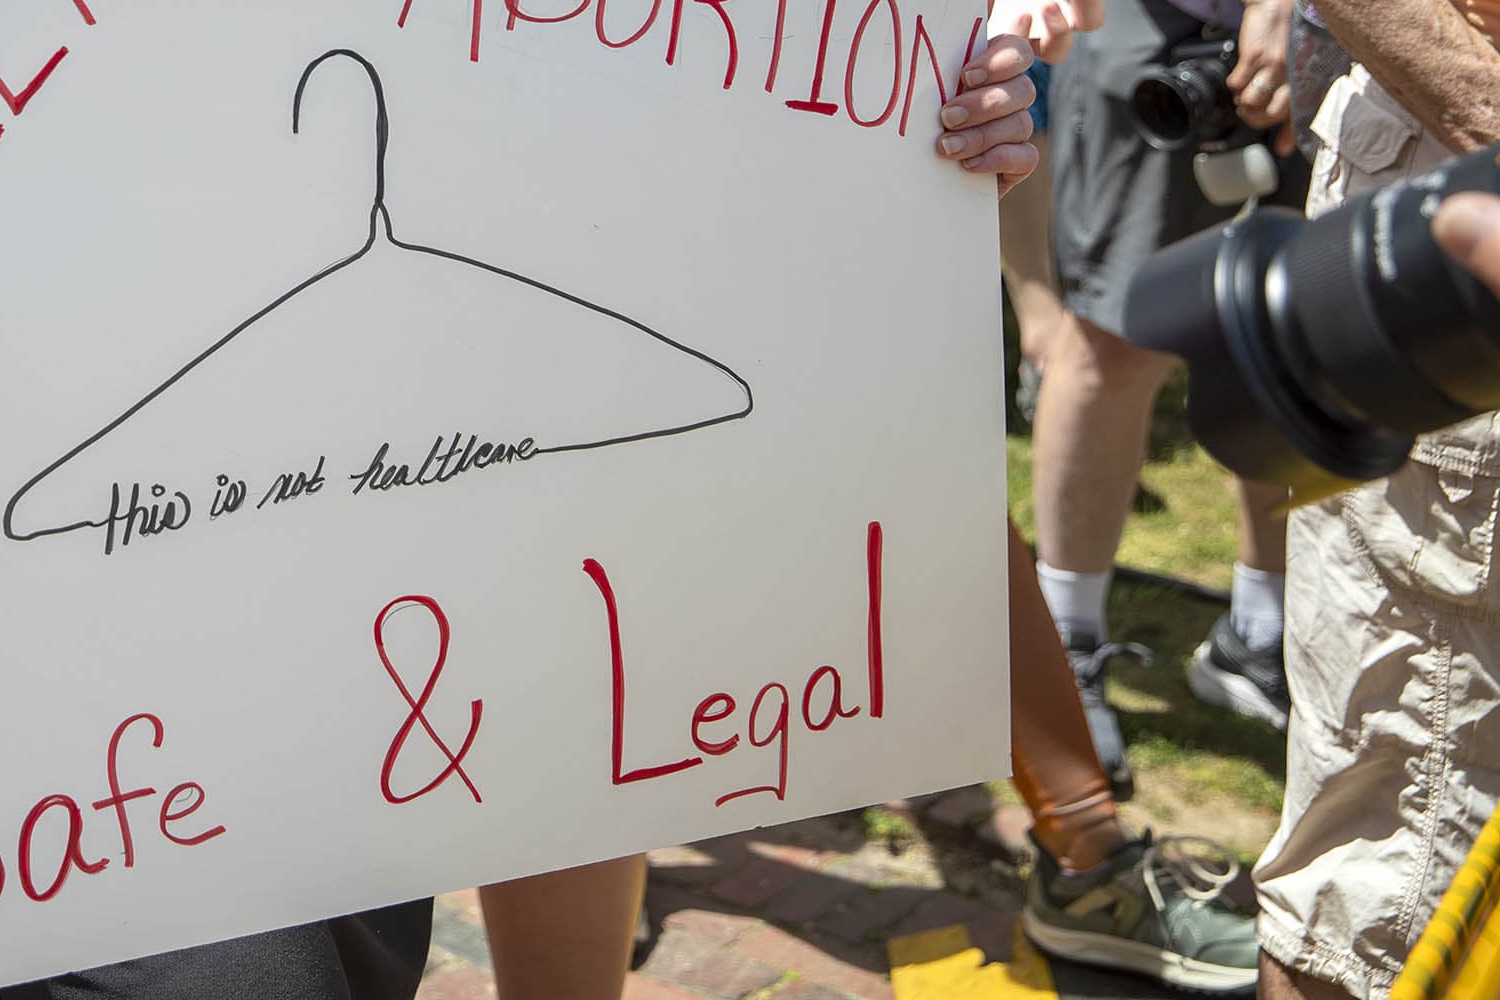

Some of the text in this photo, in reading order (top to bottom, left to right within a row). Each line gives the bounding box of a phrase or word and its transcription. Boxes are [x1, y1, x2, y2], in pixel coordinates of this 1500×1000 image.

[209, 473, 247, 520] is
[256, 455, 327, 511] not
[349, 430, 537, 496] healthcare
[373, 595, 484, 805] &
[582, 521, 885, 808] Legal
